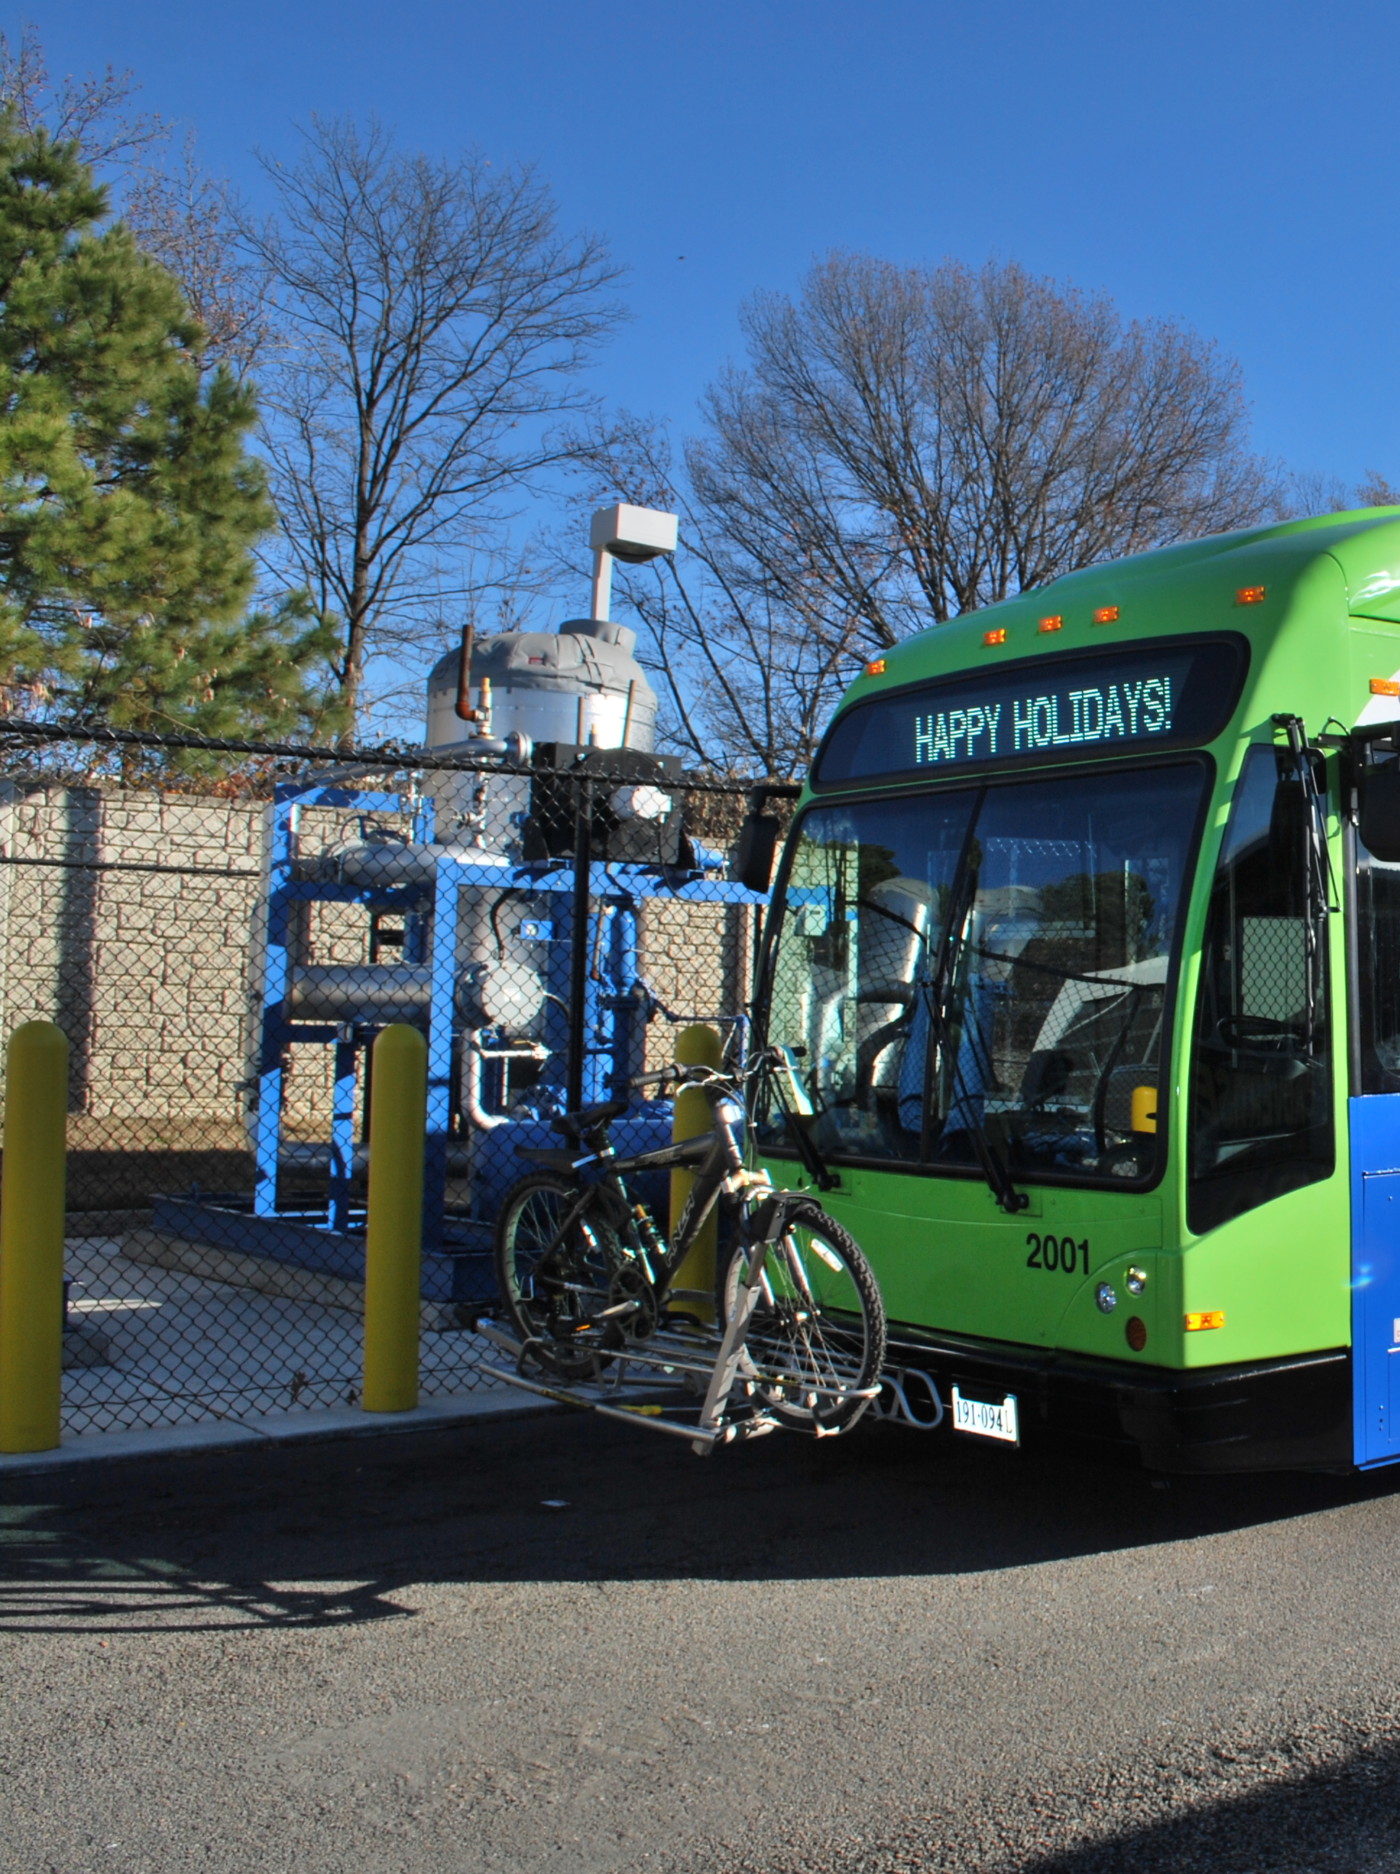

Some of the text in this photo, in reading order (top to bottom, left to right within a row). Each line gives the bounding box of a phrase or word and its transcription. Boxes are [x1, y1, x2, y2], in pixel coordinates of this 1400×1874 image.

[915, 676, 1172, 764] HAPPY HOLIDAYS!
[1025, 1232, 1089, 1276] 2001
